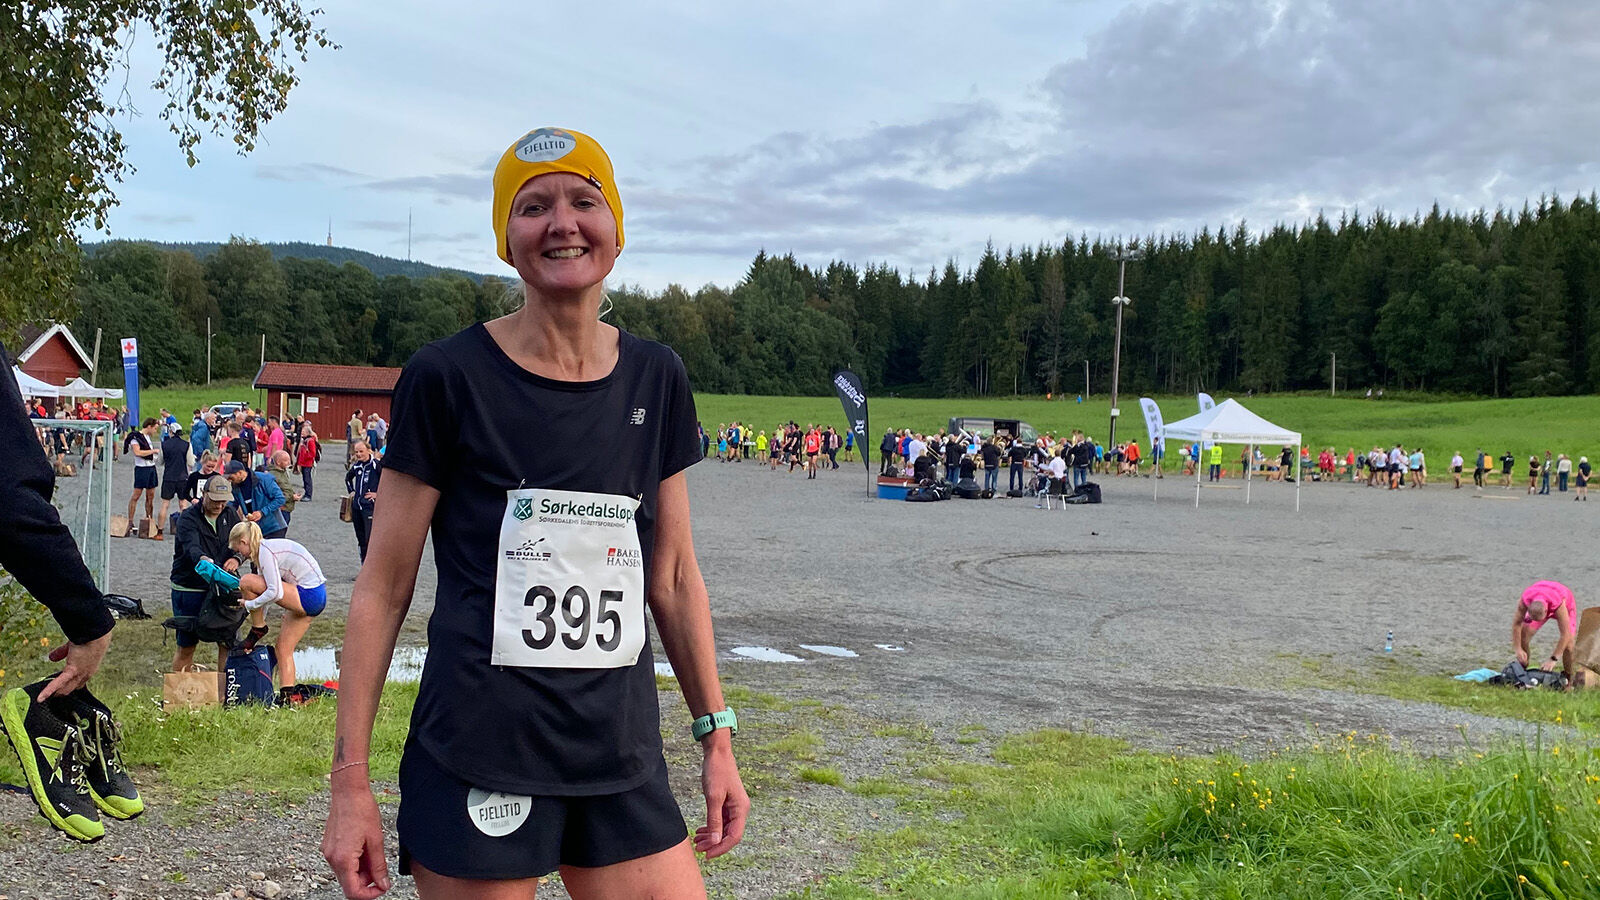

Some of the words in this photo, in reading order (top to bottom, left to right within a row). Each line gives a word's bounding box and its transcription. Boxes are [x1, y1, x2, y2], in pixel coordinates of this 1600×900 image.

[524, 141, 565, 155] FJELLTID
[540, 498, 634, 523] Sørkedalsløp
[607, 557, 640, 567] HANSEN
[521, 585, 624, 652] 395
[479, 802, 521, 821] FJELLTID
